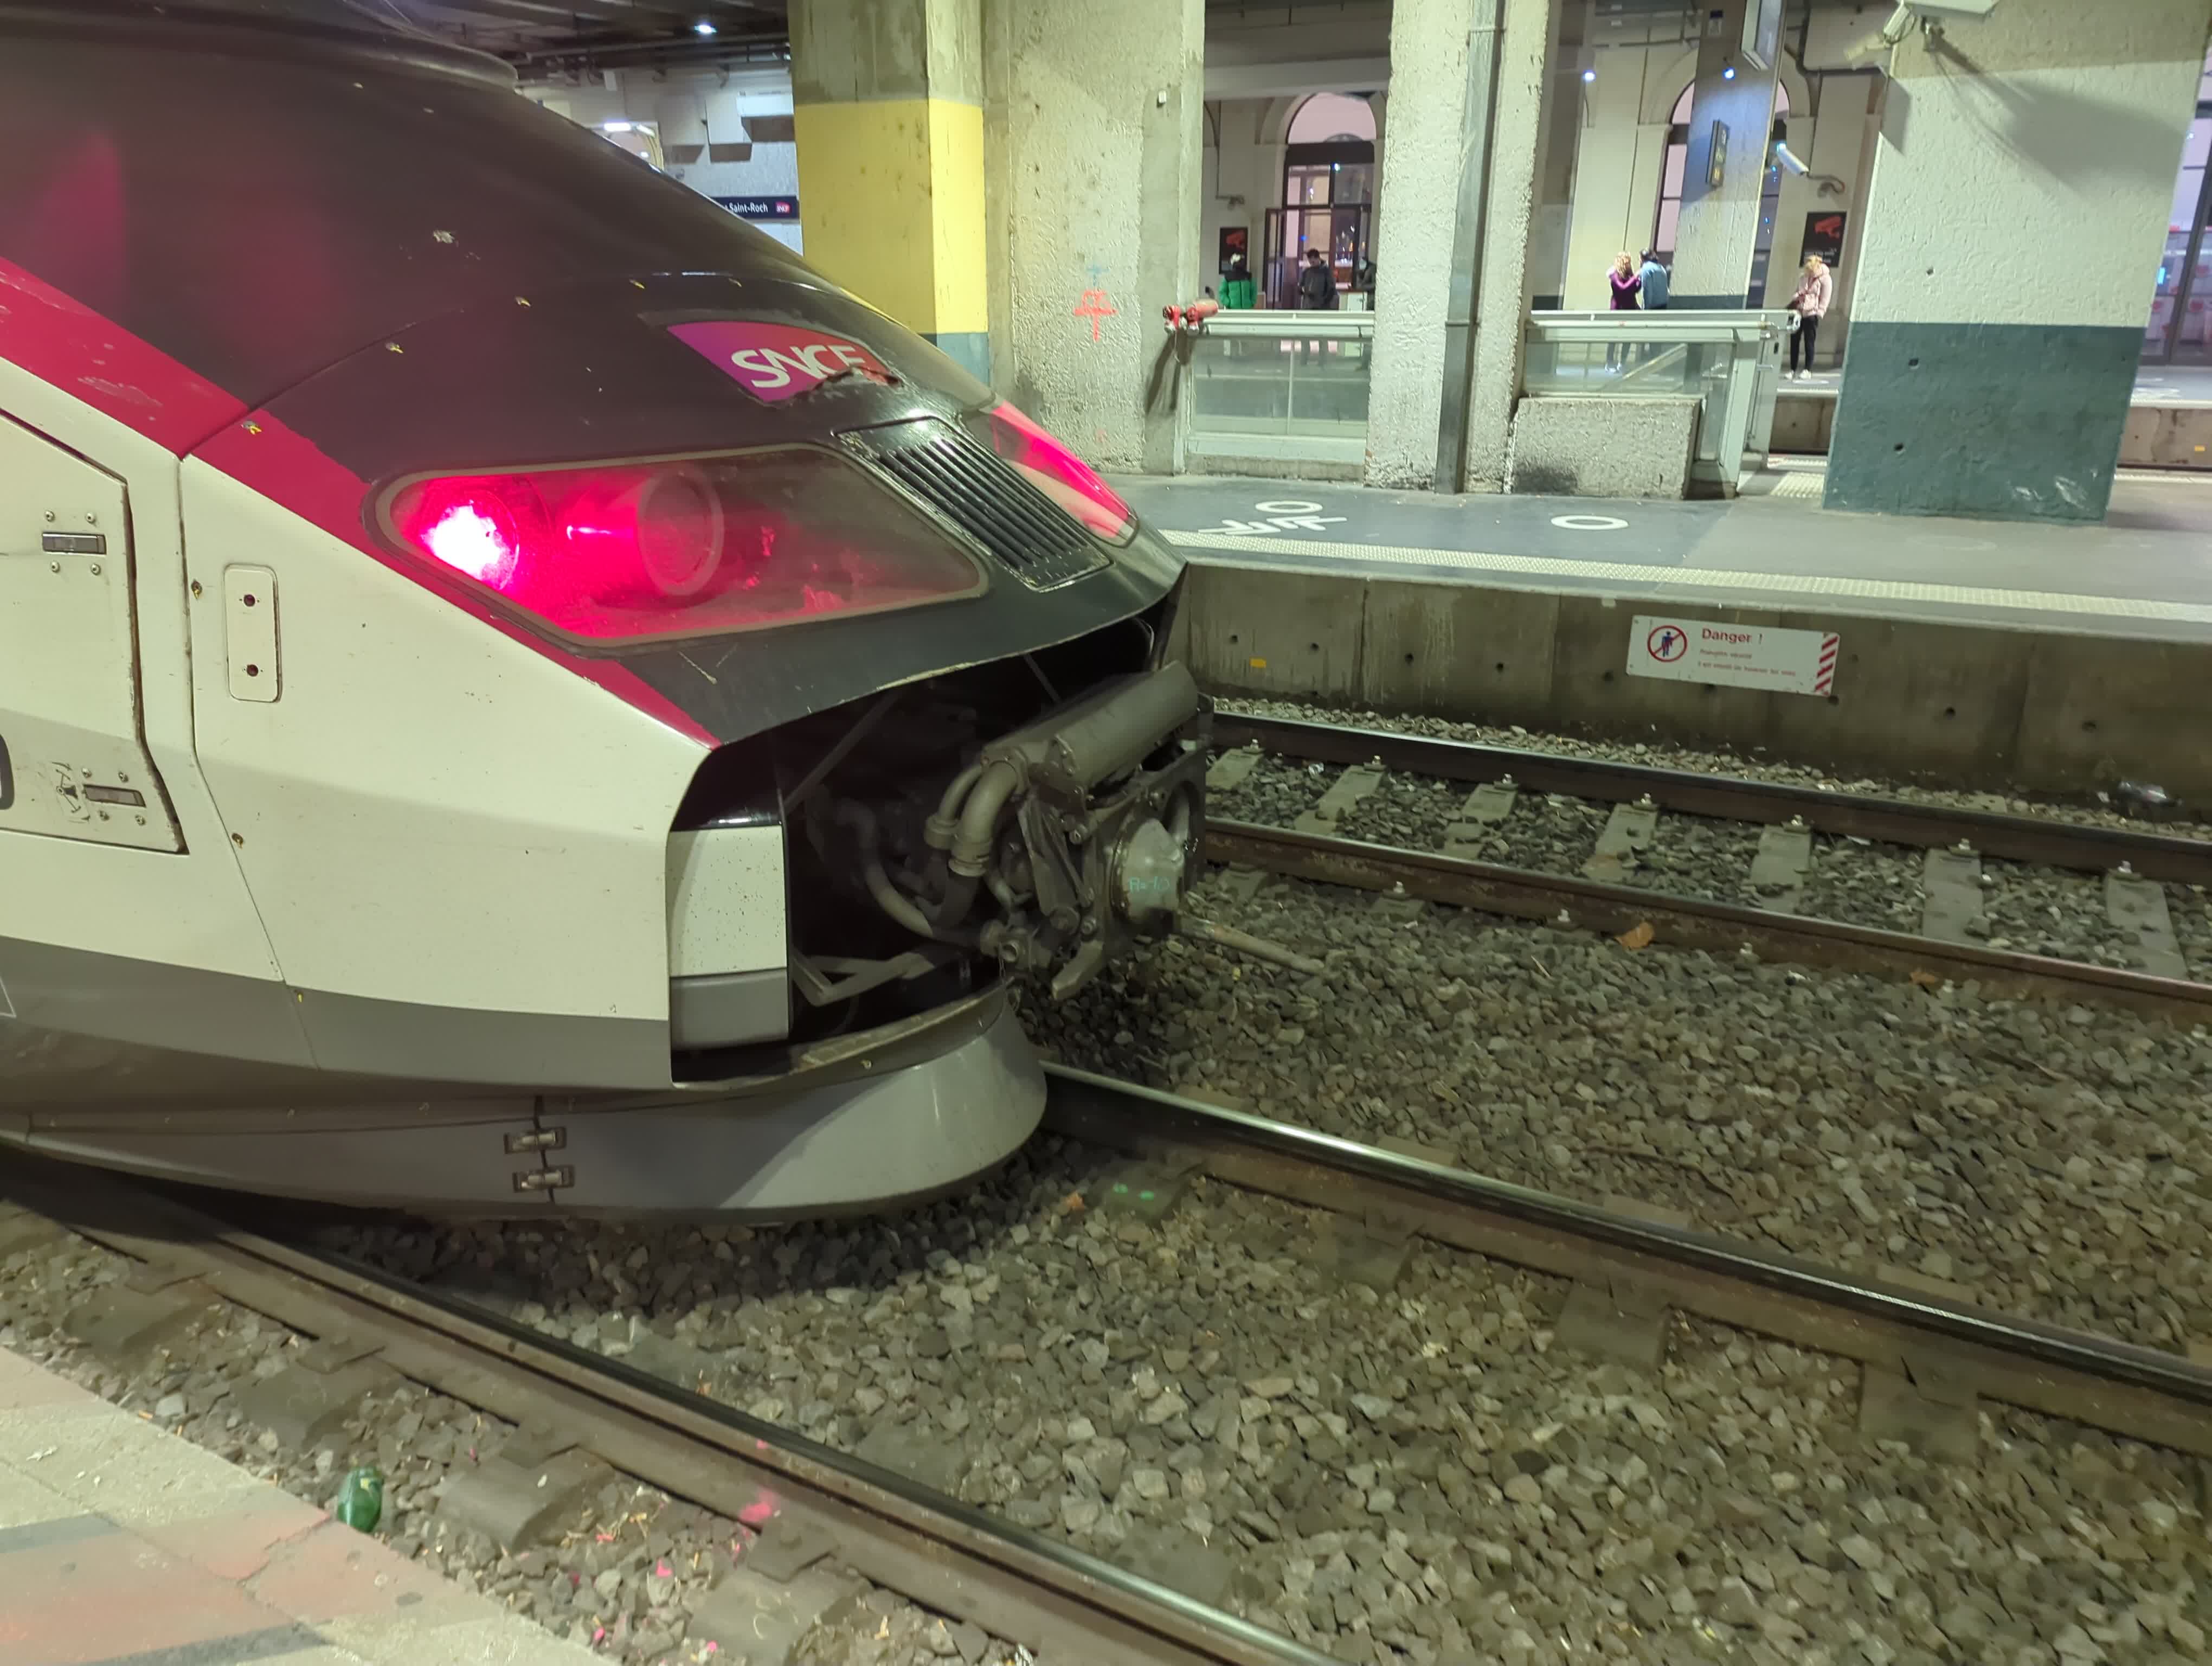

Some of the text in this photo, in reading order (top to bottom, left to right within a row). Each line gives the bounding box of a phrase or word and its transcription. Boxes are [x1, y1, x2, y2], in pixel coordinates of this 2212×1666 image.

[729, 202, 768, 213] Saint-Roch
[731, 345, 866, 388] SNCF
[1702, 628, 1752, 644] Danger
